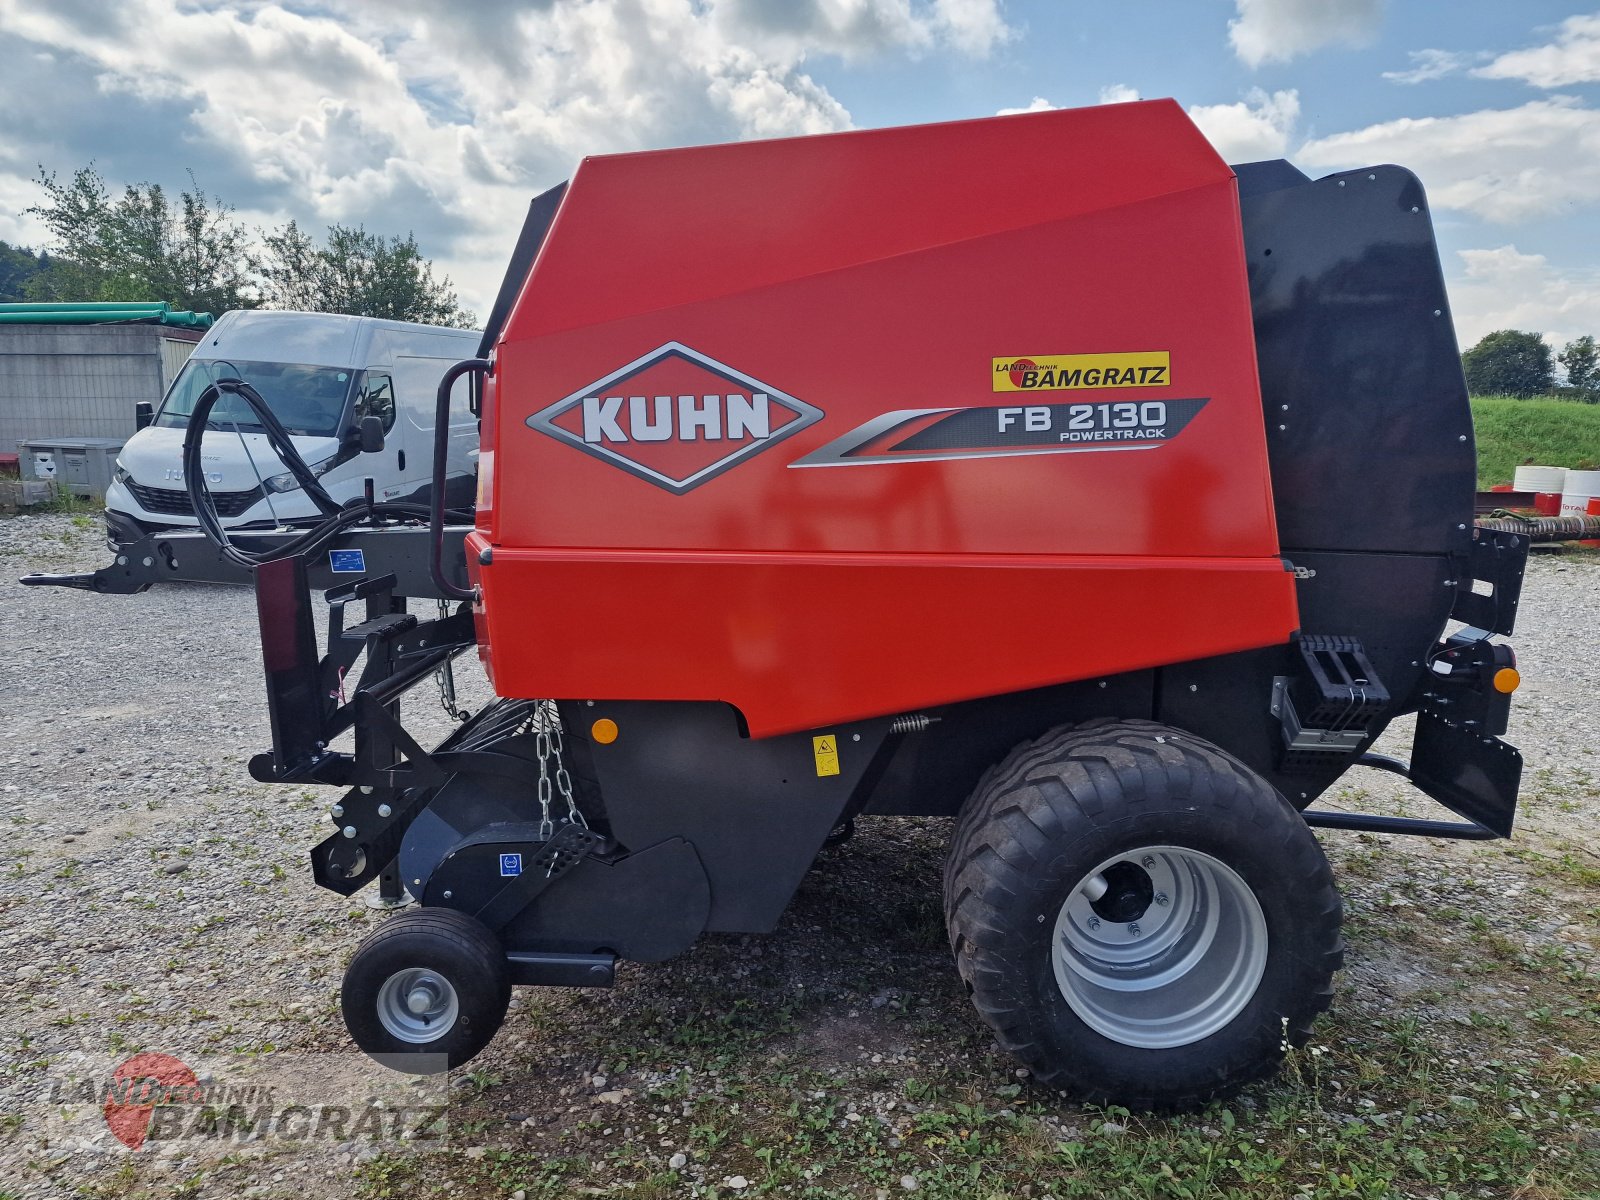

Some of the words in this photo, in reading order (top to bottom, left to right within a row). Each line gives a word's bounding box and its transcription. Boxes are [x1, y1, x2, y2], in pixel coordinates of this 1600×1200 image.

[1020, 366, 1167, 388] BAMGRATZ
[583, 393, 770, 442] KUHN
[998, 406, 1052, 433] FB
[1069, 401, 1166, 430] 2130
[1060, 428, 1166, 442] POWERTRACK
[165, 468, 223, 483] IVO
